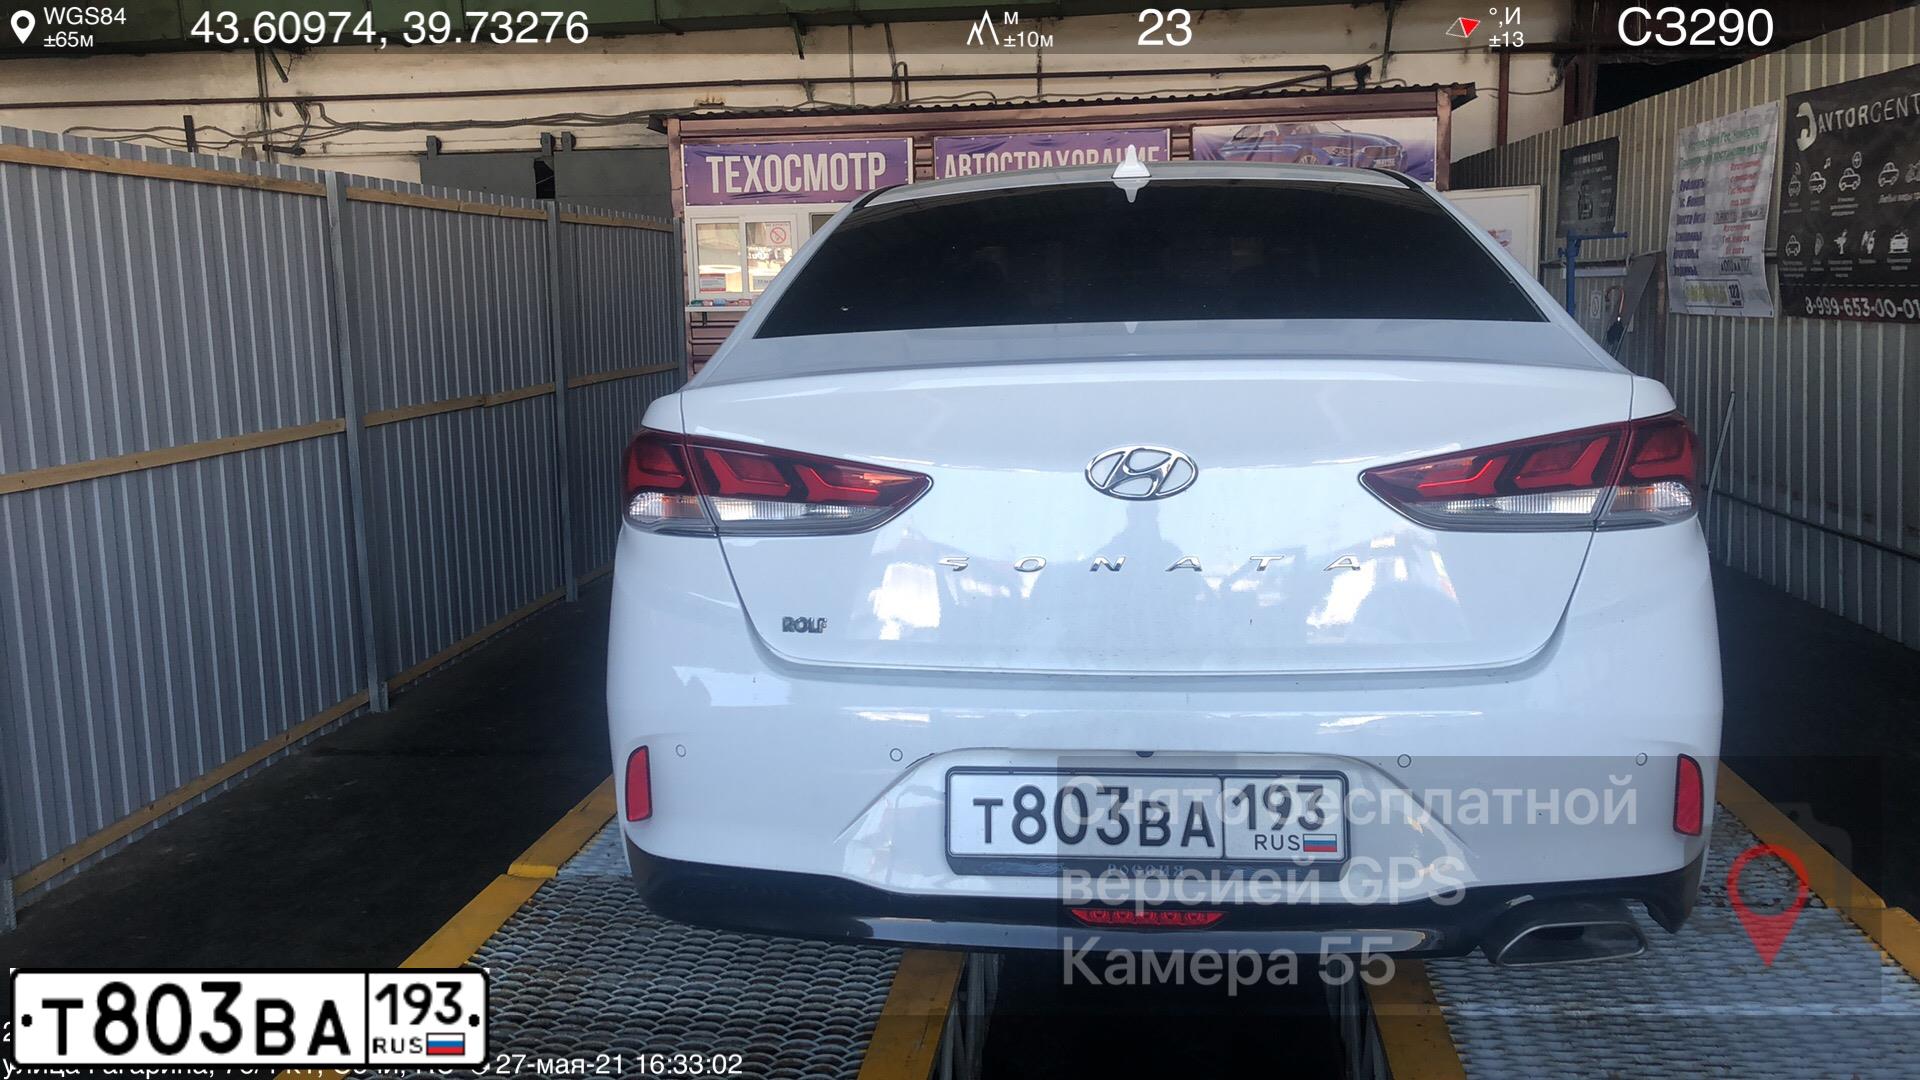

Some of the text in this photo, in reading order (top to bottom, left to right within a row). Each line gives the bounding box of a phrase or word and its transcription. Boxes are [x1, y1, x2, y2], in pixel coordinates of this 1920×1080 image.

[706, 151, 887, 194] ТЕХОСМОТР
[1805, 296, 1920, 319] 8-999-653-00-01
[938, 555, 1362, 573] SONATA
[782, 616, 828, 634] ROLF
[1232, 783, 1326, 832] 193
[1254, 833, 1301, 851] RUS
